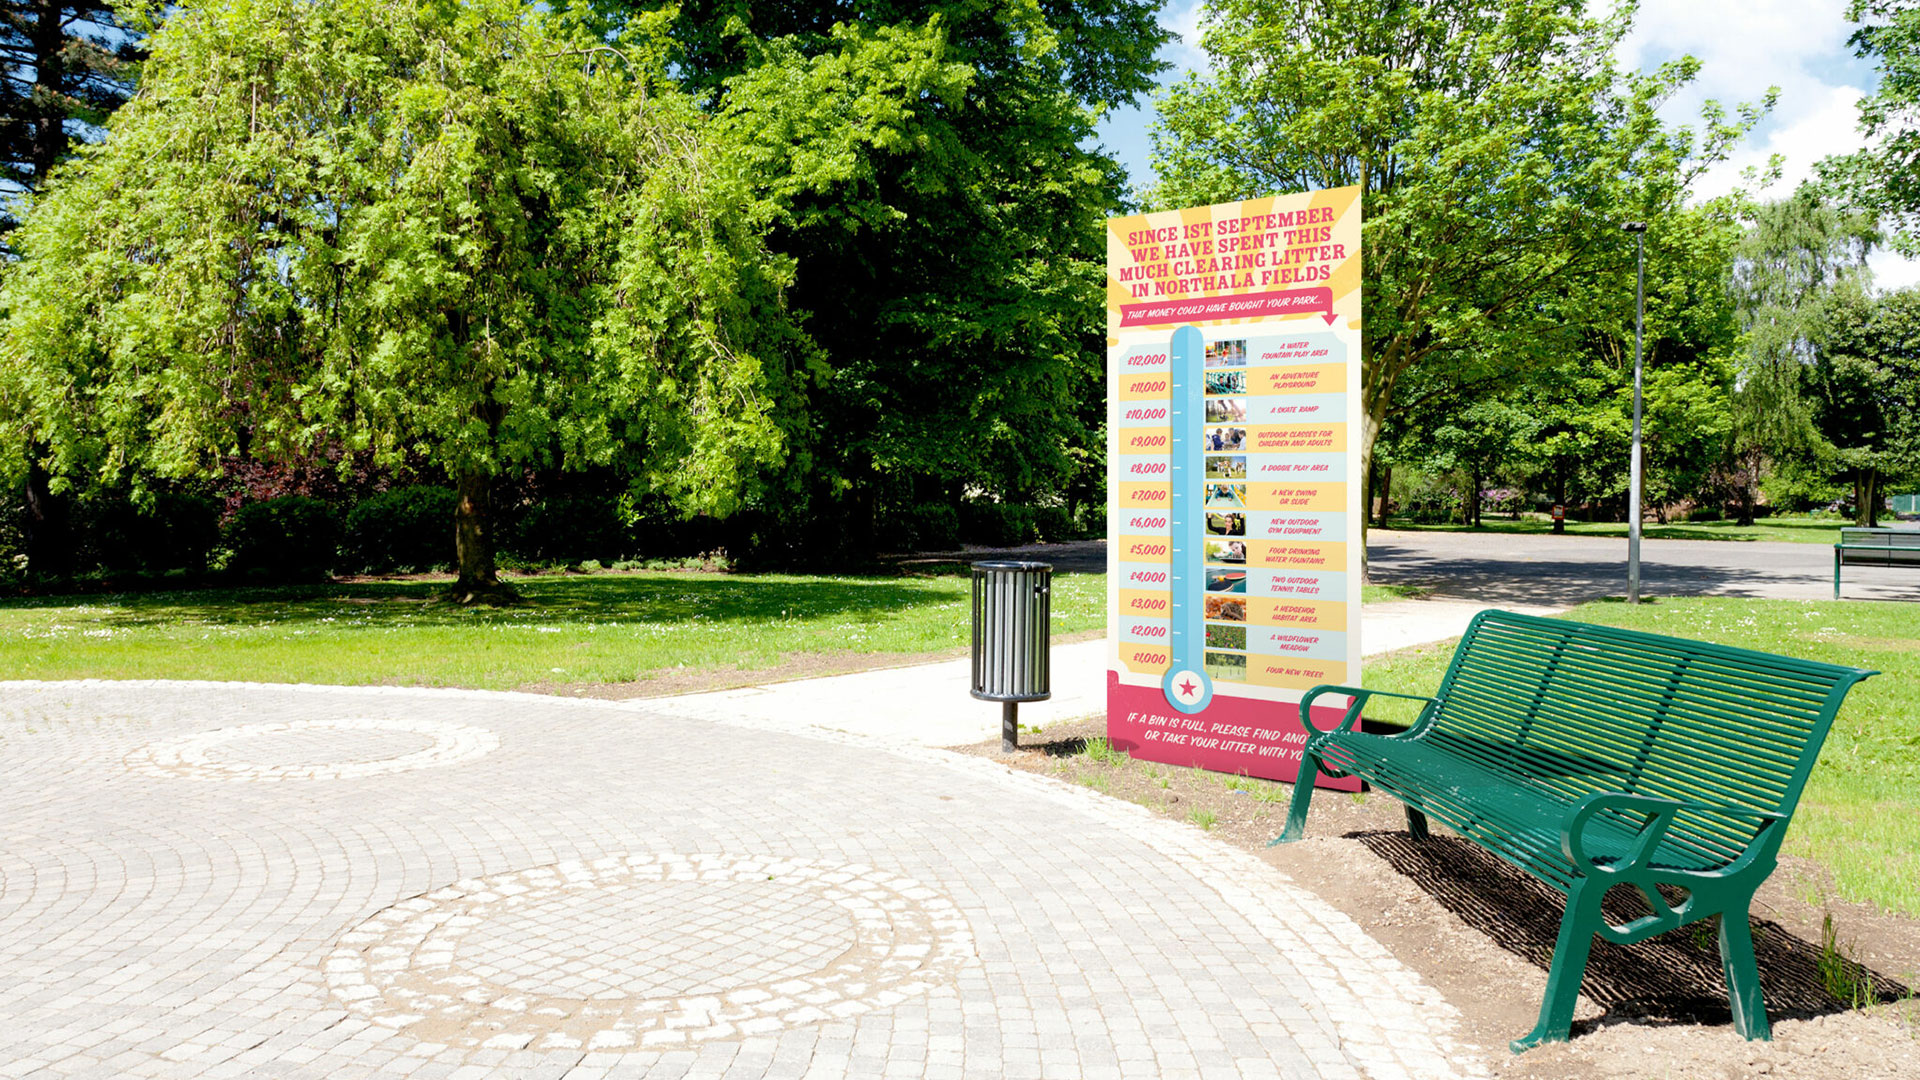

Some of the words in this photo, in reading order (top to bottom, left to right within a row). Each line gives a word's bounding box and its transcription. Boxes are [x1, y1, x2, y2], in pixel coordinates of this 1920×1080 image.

[1128, 226, 1178, 246] SINCE
[1183, 222, 1212, 239] 1ST
[1217, 206, 1334, 235] SEPTEMBER
[1131, 246, 1159, 262] WE
[1165, 240, 1213, 259] HAVE
[1218, 232, 1278, 254] SPENT
[1284, 226, 1331, 246] THIS
[1120, 263, 1168, 282] MUCH
[1174, 252, 1265, 276] CLEARING
[1271, 244, 1346, 266] LITTER
[1132, 283, 1149, 298] IN
[1155, 272, 1255, 296] NORTHALA
[1261, 264, 1331, 286] FIELDS
[1127, 310, 1147, 319] THAT
[1147, 308, 1177, 318] MONEY
[1177, 304, 1204, 315] COULD
[1206, 302, 1228, 312] HAVE
[1228, 299, 1265, 311] BOUGHT
[1267, 297, 1291, 308] YOUR
[1128, 354, 1166, 366] £12,000
[1261, 352, 1292, 360] FOUNTAIN
[1281, 371, 1320, 380] ADVENTURE
[1130, 381, 1166, 393] £11,000
[1273, 381, 1316, 389] PLAYGROUND
[1126, 408, 1166, 420] £10,000
[1130, 435, 1166, 447] £9,000
[1130, 463, 1166, 474] £8,000
[1131, 490, 1166, 501] £7,000
[1130, 517, 1166, 528] £6,000
[1130, 544, 1166, 555] £5,000
[1130, 572, 1166, 583] £4,000
[1295, 586, 1320, 594] TABLES
[1131, 598, 1166, 610] £3,000
[1280, 606, 1316, 614] HEDGEHOG
[1131, 625, 1166, 637] £2,000
[1277, 634, 1319, 644] WILDFLOWER
[1133, 653, 1166, 664] £1,000
[1302, 670, 1324, 678] TREES
[1127, 712, 1138, 722] IF
[1139, 714, 1147, 724] A
[1148, 715, 1168, 726] BIN
[1168, 718, 1180, 728] IS
[1211, 722, 1252, 737] PLEASE
[1252, 728, 1281, 741] FIND
[1282, 732, 1309, 744] ANO
[1144, 730, 1160, 740] OR
[1162, 732, 1188, 745] TAKE
[1190, 736, 1219, 749] YOUR
[1220, 740, 1257, 754] LITTER
[1259, 745, 1288, 758] WITH
[1290, 749, 1304, 761] YO
